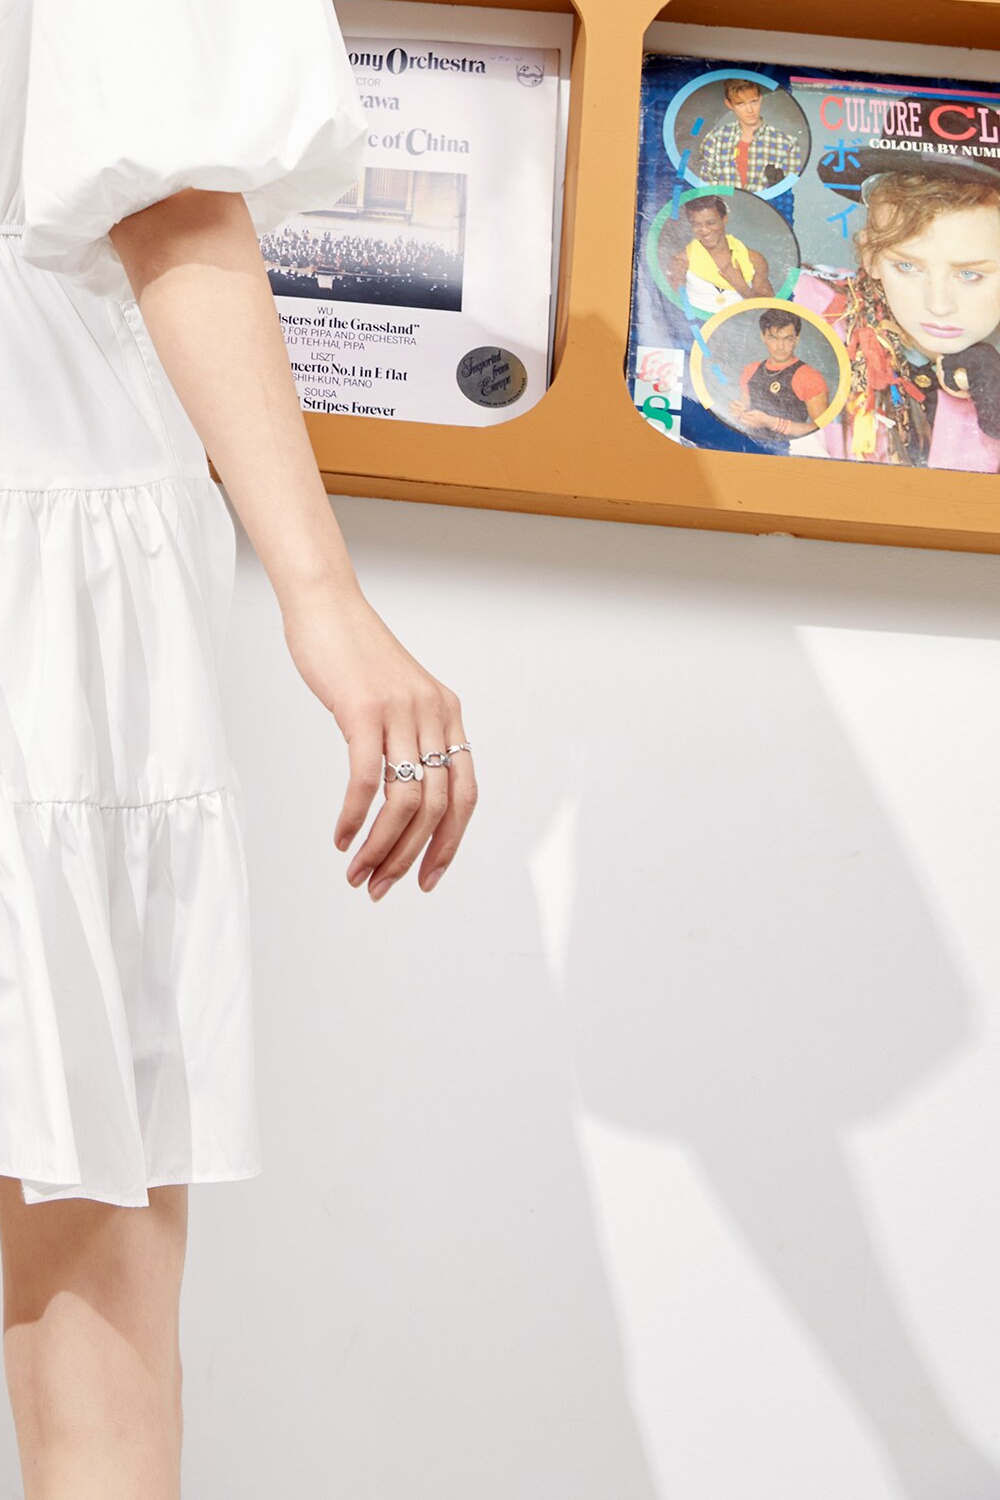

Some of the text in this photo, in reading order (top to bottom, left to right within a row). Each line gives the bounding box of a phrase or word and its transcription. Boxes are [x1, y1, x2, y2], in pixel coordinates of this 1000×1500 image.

[385, 47, 487, 75] Orchestra
[819, 95, 1000, 143] CULTURE CL
[382, 130, 404, 149] of
[405, 127, 470, 156] China
[869, 137, 935, 154] COLOUR
[937, 145, 959, 156] BY
[821, 137, 863, 239] ボーイ
[317, 306, 333, 316] WU
[278, 313, 312, 326] isters
[313, 315, 326, 327] of
[328, 317, 349, 330] the
[288, 326, 417, 346] FOR PIPA AND ORCHESTRA
[301, 337, 341, 350] TEH-HAI,
[343, 340, 365, 350] PIPA
[310, 351, 336, 361] LISZT
[290, 362, 408, 381] ncerto No.1 in E flat
[304, 386, 338, 398] SOUSA
[343, 378, 373, 389] PIANO
[303, 396, 396, 417] Stripes Forever
